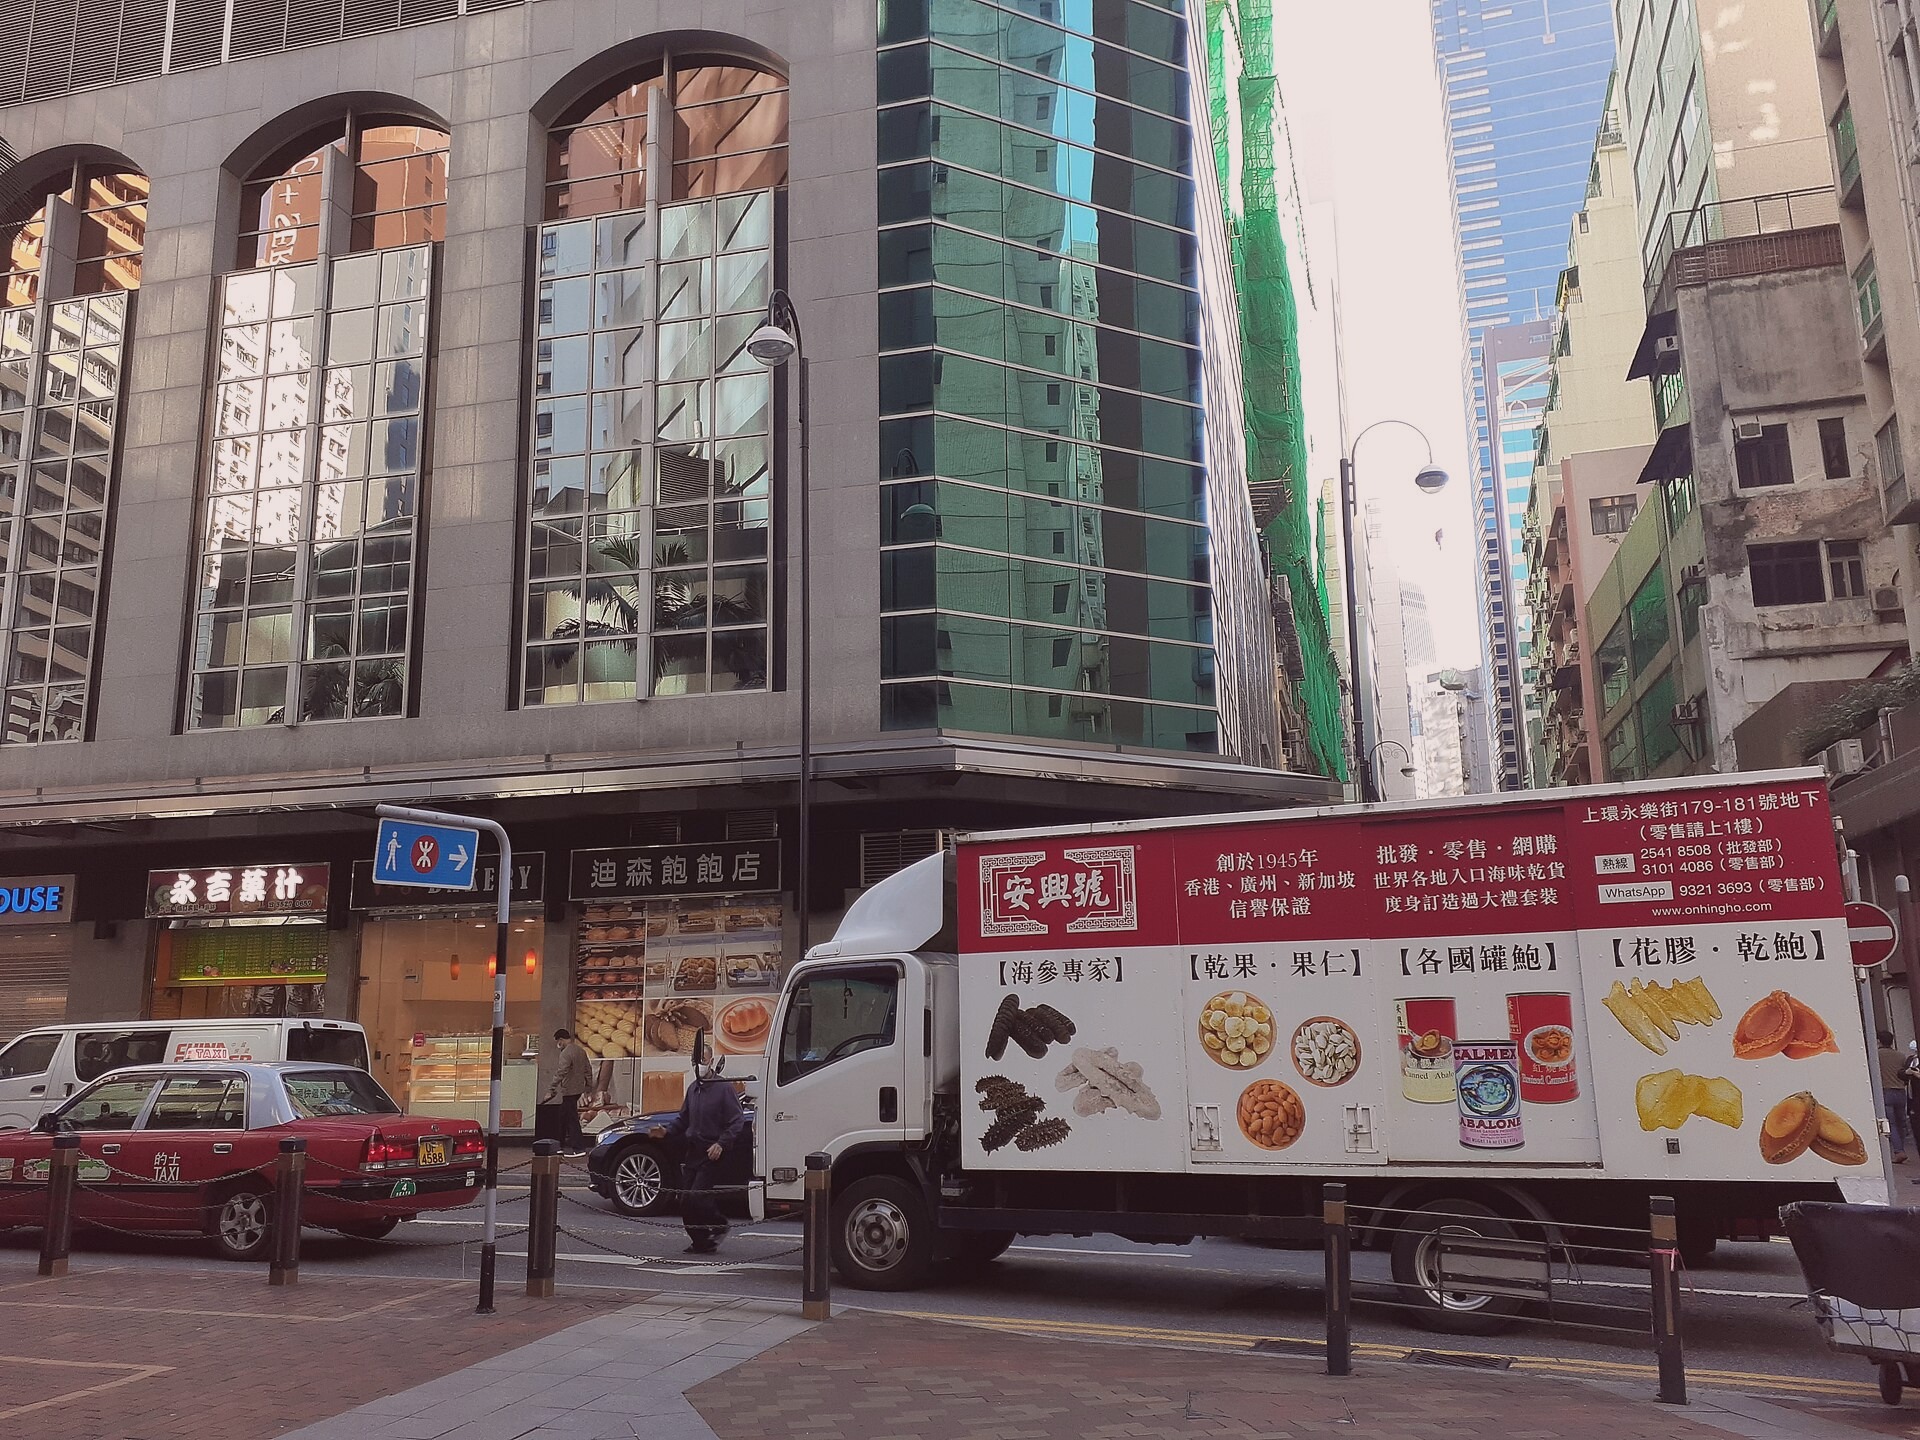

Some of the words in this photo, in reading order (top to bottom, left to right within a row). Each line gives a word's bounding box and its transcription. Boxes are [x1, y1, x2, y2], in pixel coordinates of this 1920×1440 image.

[1582, 790, 1821, 824] 上環永樂街179-181號地下
[1641, 847, 1673, 859] 2541
[1677, 844, 1712, 857] 8508
[1216, 848, 1318, 873] 創於1945年
[1602, 857, 1629, 870] 熱線
[1642, 863, 1674, 875] 3101
[1679, 861, 1714, 873] 4086
[590, 851, 761, 888] 迪森飽飽店
[1373, 861, 1566, 890] 世界各地入口海味乾貨
[169, 867, 304, 905] 永吉菓汁
[1003, 869, 1111, 910] 安興號
[1184, 870, 1356, 896] 香港、廣州、新加坡
[1605, 885, 1666, 899] WhatsApp
[1679, 883, 1712, 896] 9321
[1717, 881, 1752, 894] 3693
[1229, 896, 1312, 919] 信譽保證
[1385, 888, 1559, 914] 度身訂造過大禮套裝
[1652, 901, 1772, 916] www.onhingho.com
[195, 1048, 227, 1060] TAXI
[1453, 1048, 1517, 1061] CALMEX
[1459, 1116, 1522, 1130] ABALONE
[153, 1151, 181, 1166] 的士
[421, 1152, 444, 1165] 4588
[153, 1166, 180, 1181] TAXI
[401, 1183, 407, 1191] 4
